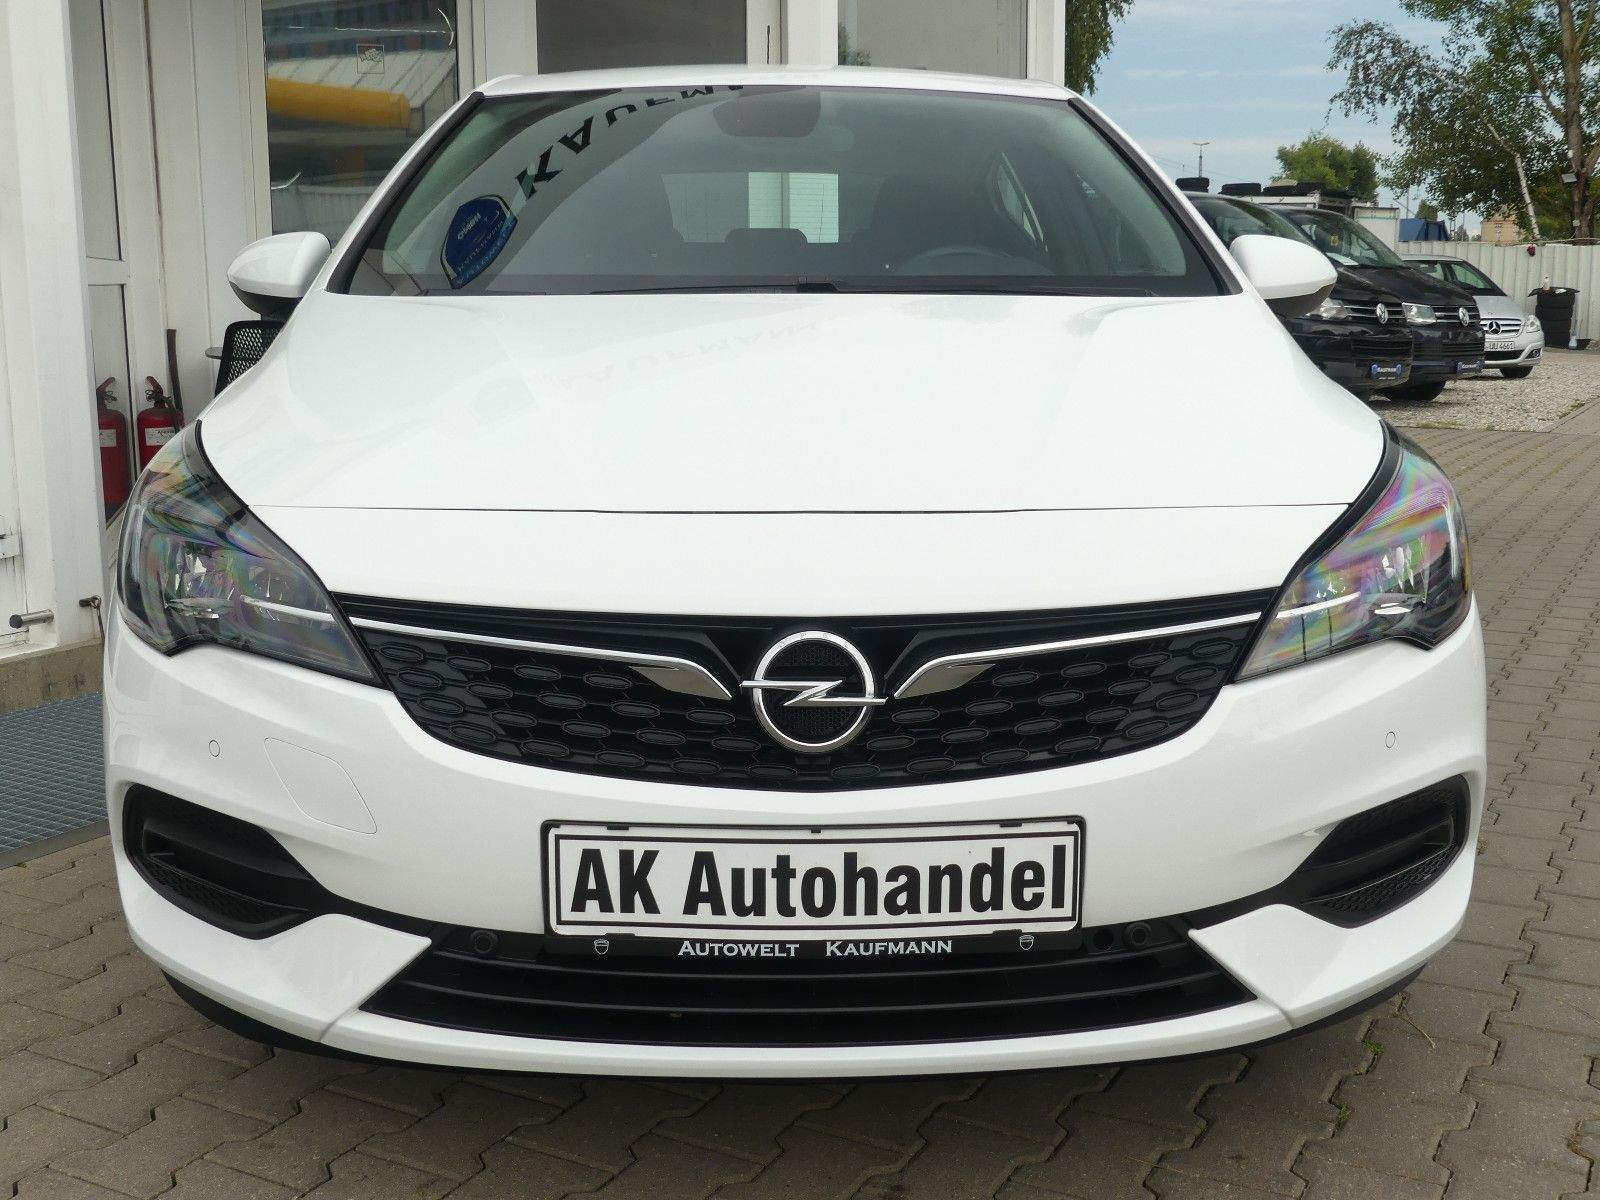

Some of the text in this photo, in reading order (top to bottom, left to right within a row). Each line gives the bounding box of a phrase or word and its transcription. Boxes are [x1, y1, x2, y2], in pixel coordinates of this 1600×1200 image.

[569, 844, 1068, 919] AK Autohandel
[678, 940, 953, 957] AUTOWELT KAUFMANN
